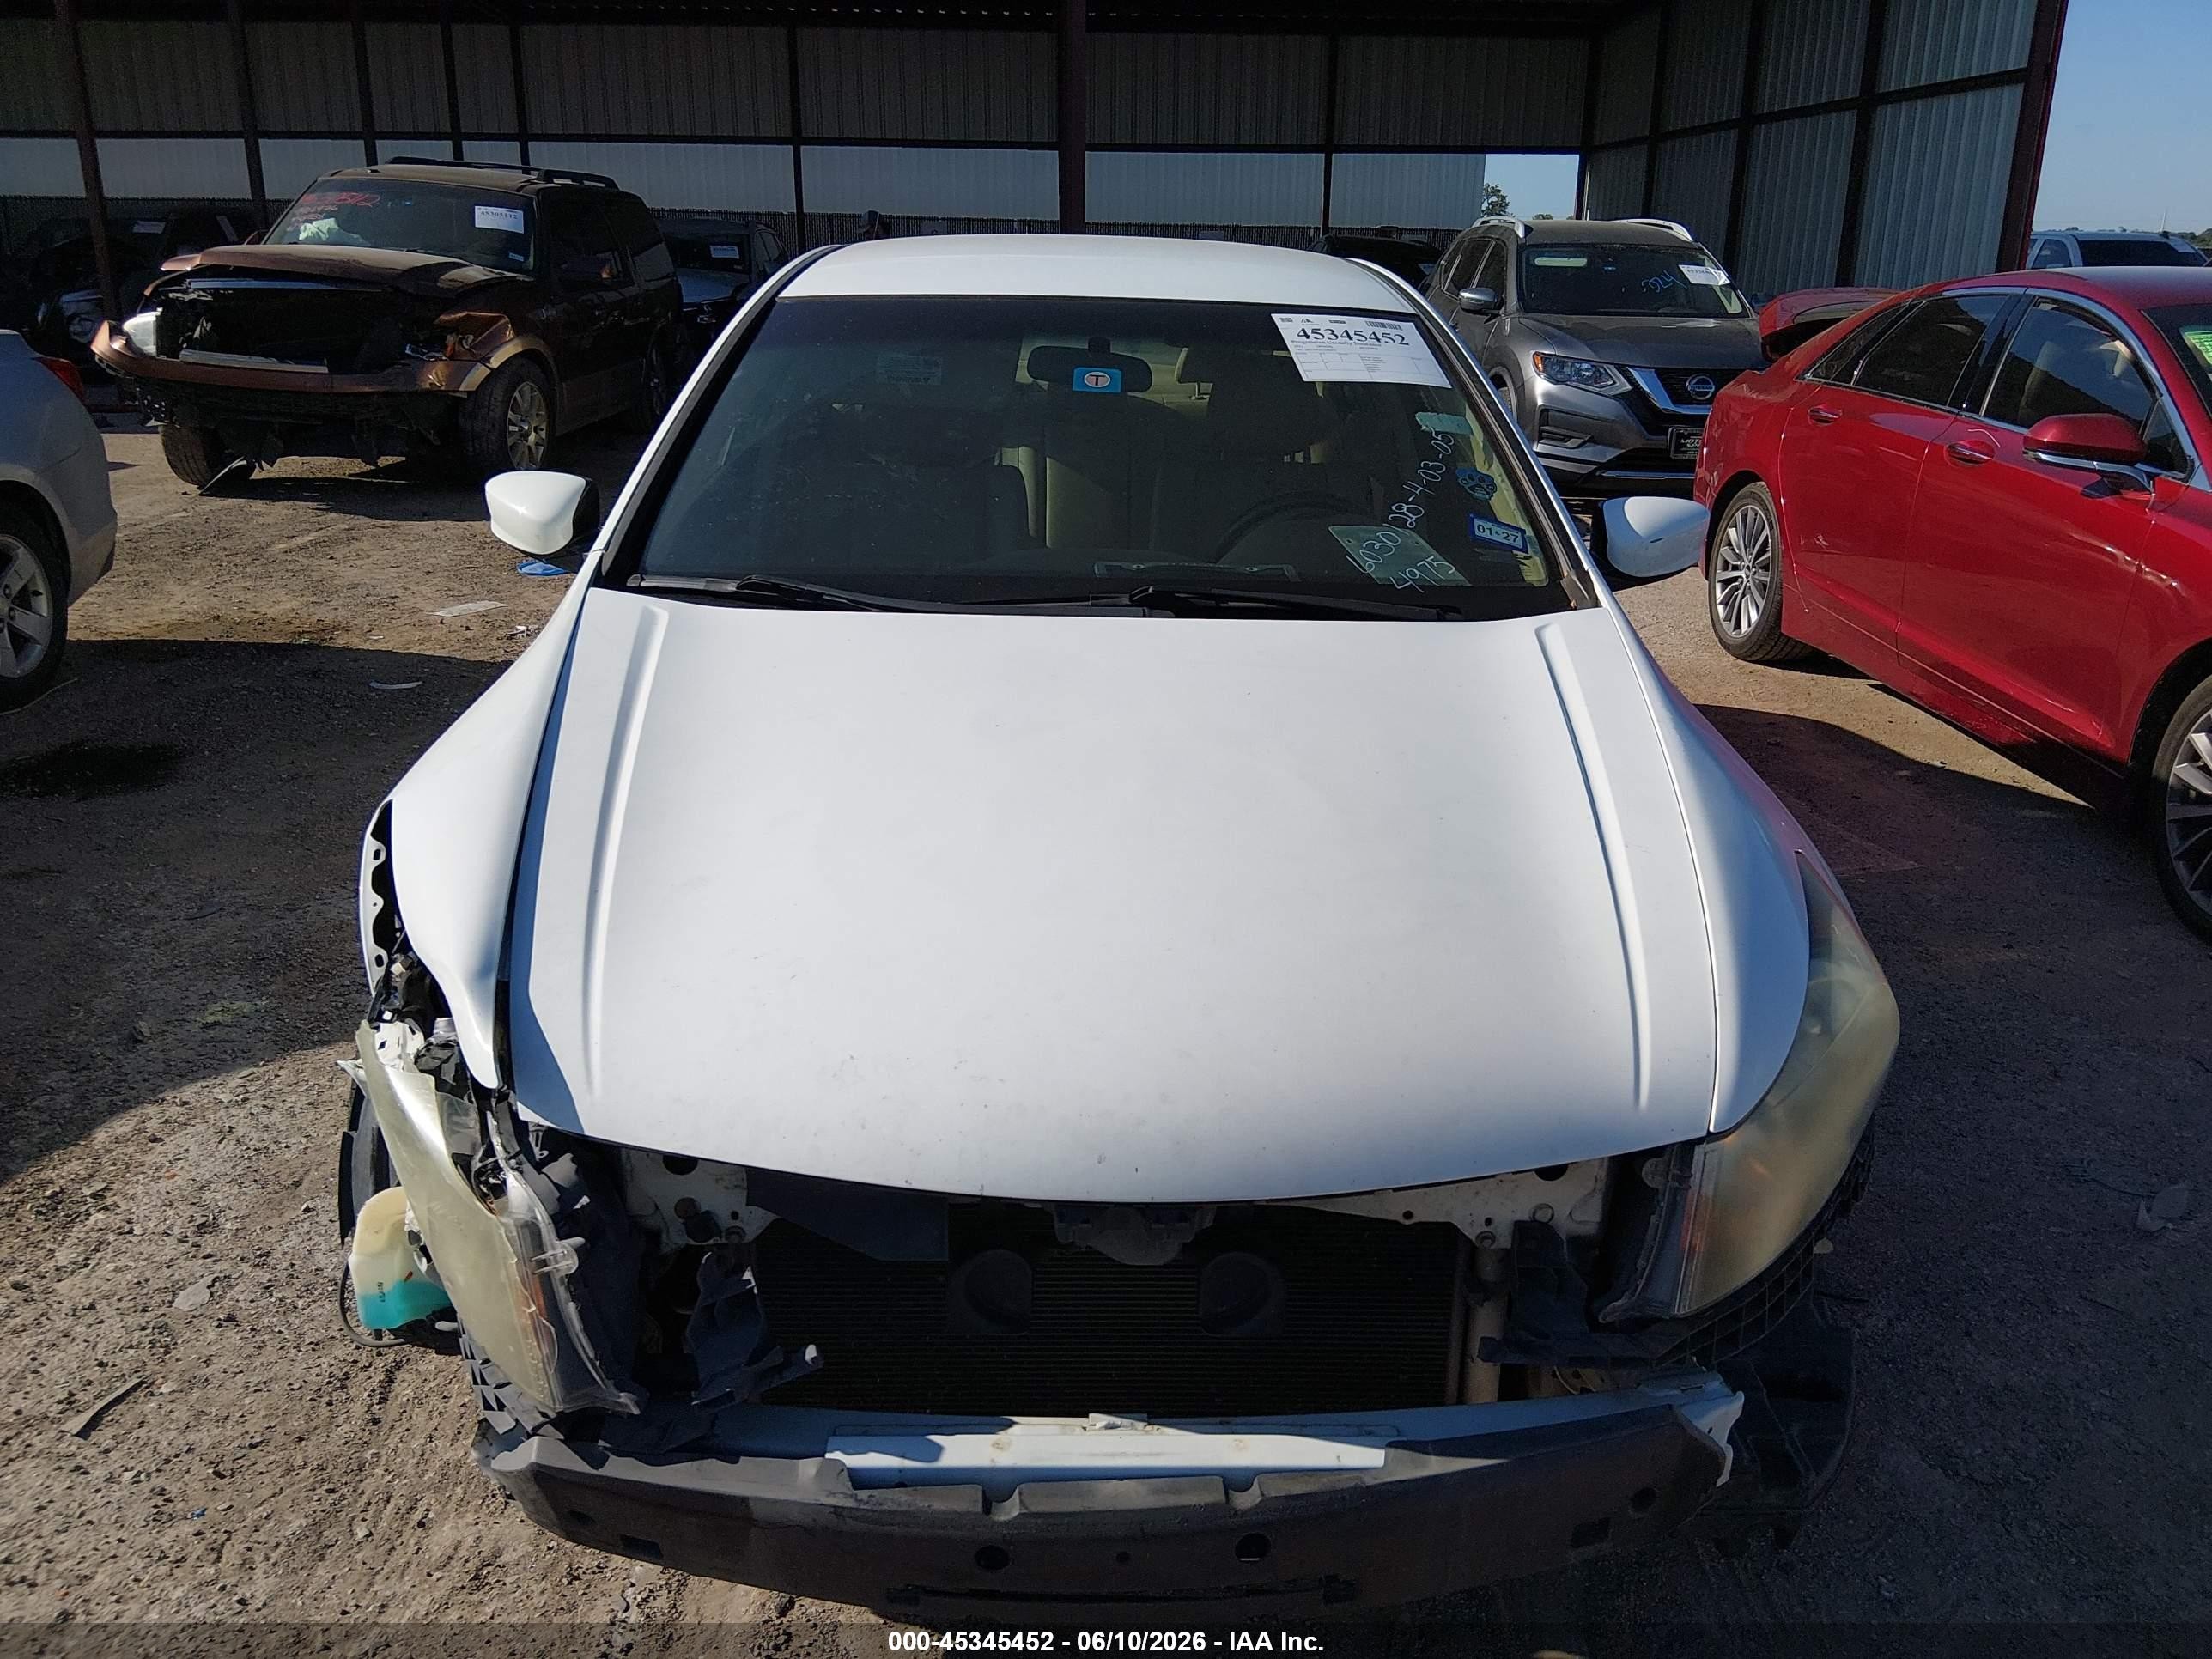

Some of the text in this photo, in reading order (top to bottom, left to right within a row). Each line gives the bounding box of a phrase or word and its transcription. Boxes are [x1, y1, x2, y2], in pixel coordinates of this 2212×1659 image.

[1297, 327, 1409, 346] 45345452
[1090, 374, 1107, 386] T
[1389, 555, 1455, 592] 4975
